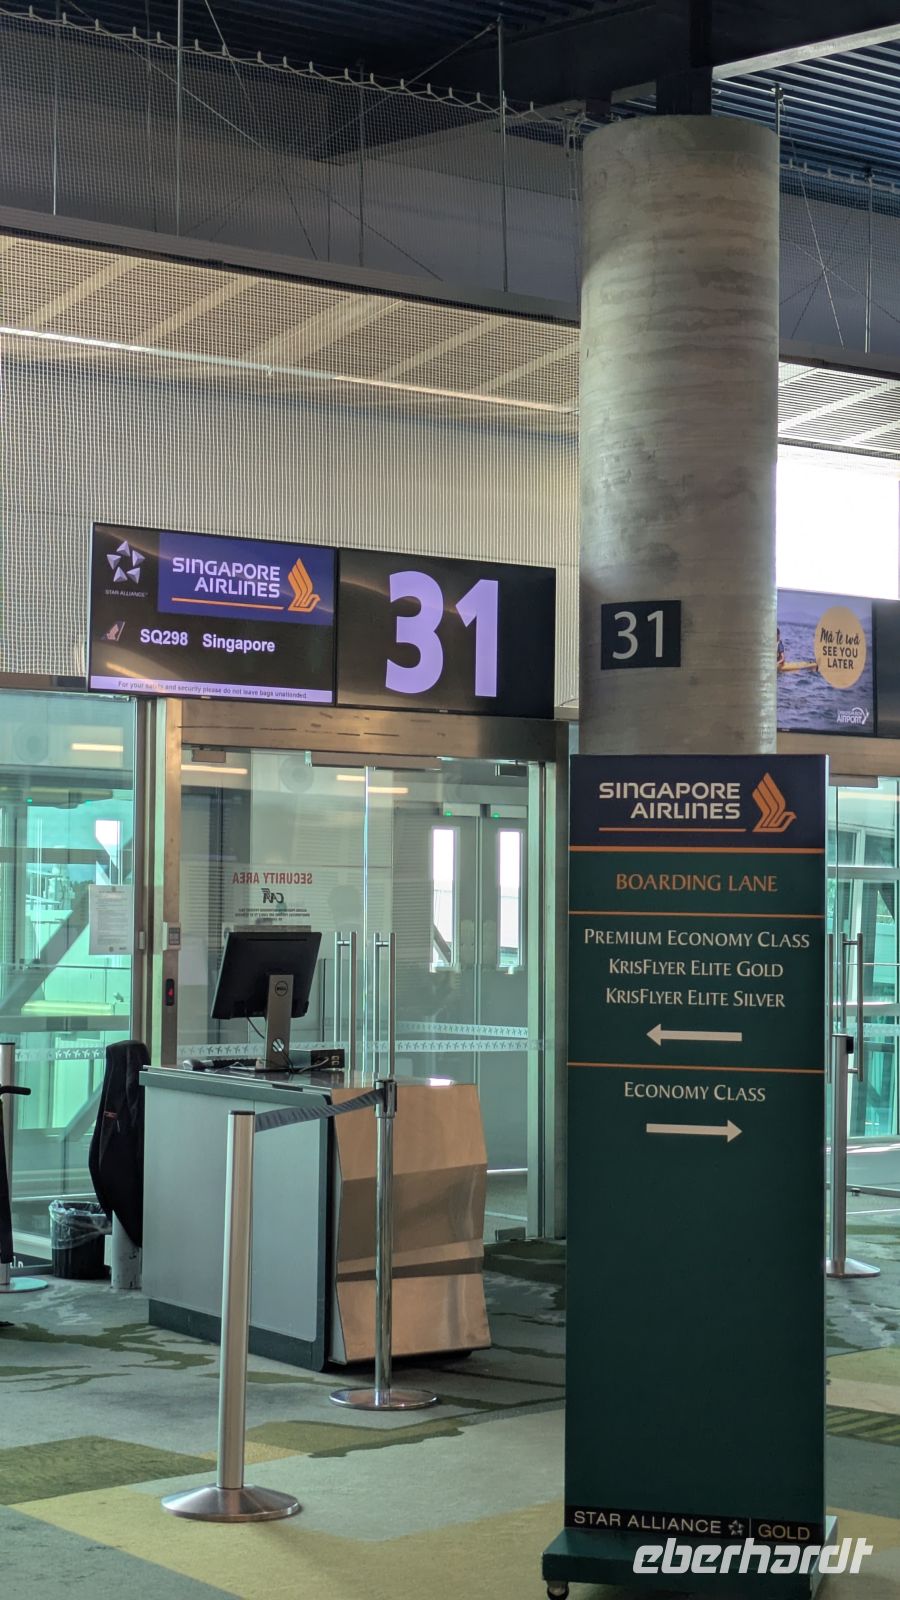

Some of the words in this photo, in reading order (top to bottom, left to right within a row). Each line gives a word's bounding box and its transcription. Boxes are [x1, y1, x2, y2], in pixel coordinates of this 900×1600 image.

[172, 557, 280, 581] SINGAPORE
[194, 577, 280, 598] AIRLINES
[140, 628, 189, 646] SQ298
[202, 633, 276, 654] Singapore
[385, 570, 498, 698] 31
[612, 610, 663, 660] 31
[822, 645, 837, 657] SEE
[839, 647, 858, 658] YOU
[827, 657, 854, 670] LATER
[178, 685, 201, 693] security
[259, 690, 273, 698] bags
[598, 782, 741, 800] SINGAPORE
[630, 802, 741, 820] AIRLINES
[615, 873, 721, 892] BOARDING
[728, 875, 778, 893] LANE
[584, 928, 662, 946] PREMIUM
[667, 929, 753, 948] ECONOMY
[757, 931, 811, 948] CLASS
[691, 960, 732, 977] ELITE
[736, 961, 784, 978] GOLD
[687, 990, 729, 1007] ELITE
[733, 990, 786, 1008] SILVER
[623, 1081, 710, 1101] ECONOMY
[713, 1084, 766, 1102] CLASS
[574, 1510, 621, 1528] STAR
[627, 1514, 721, 1534] ALLIANCE
[757, 1523, 810, 1541] GOLD
